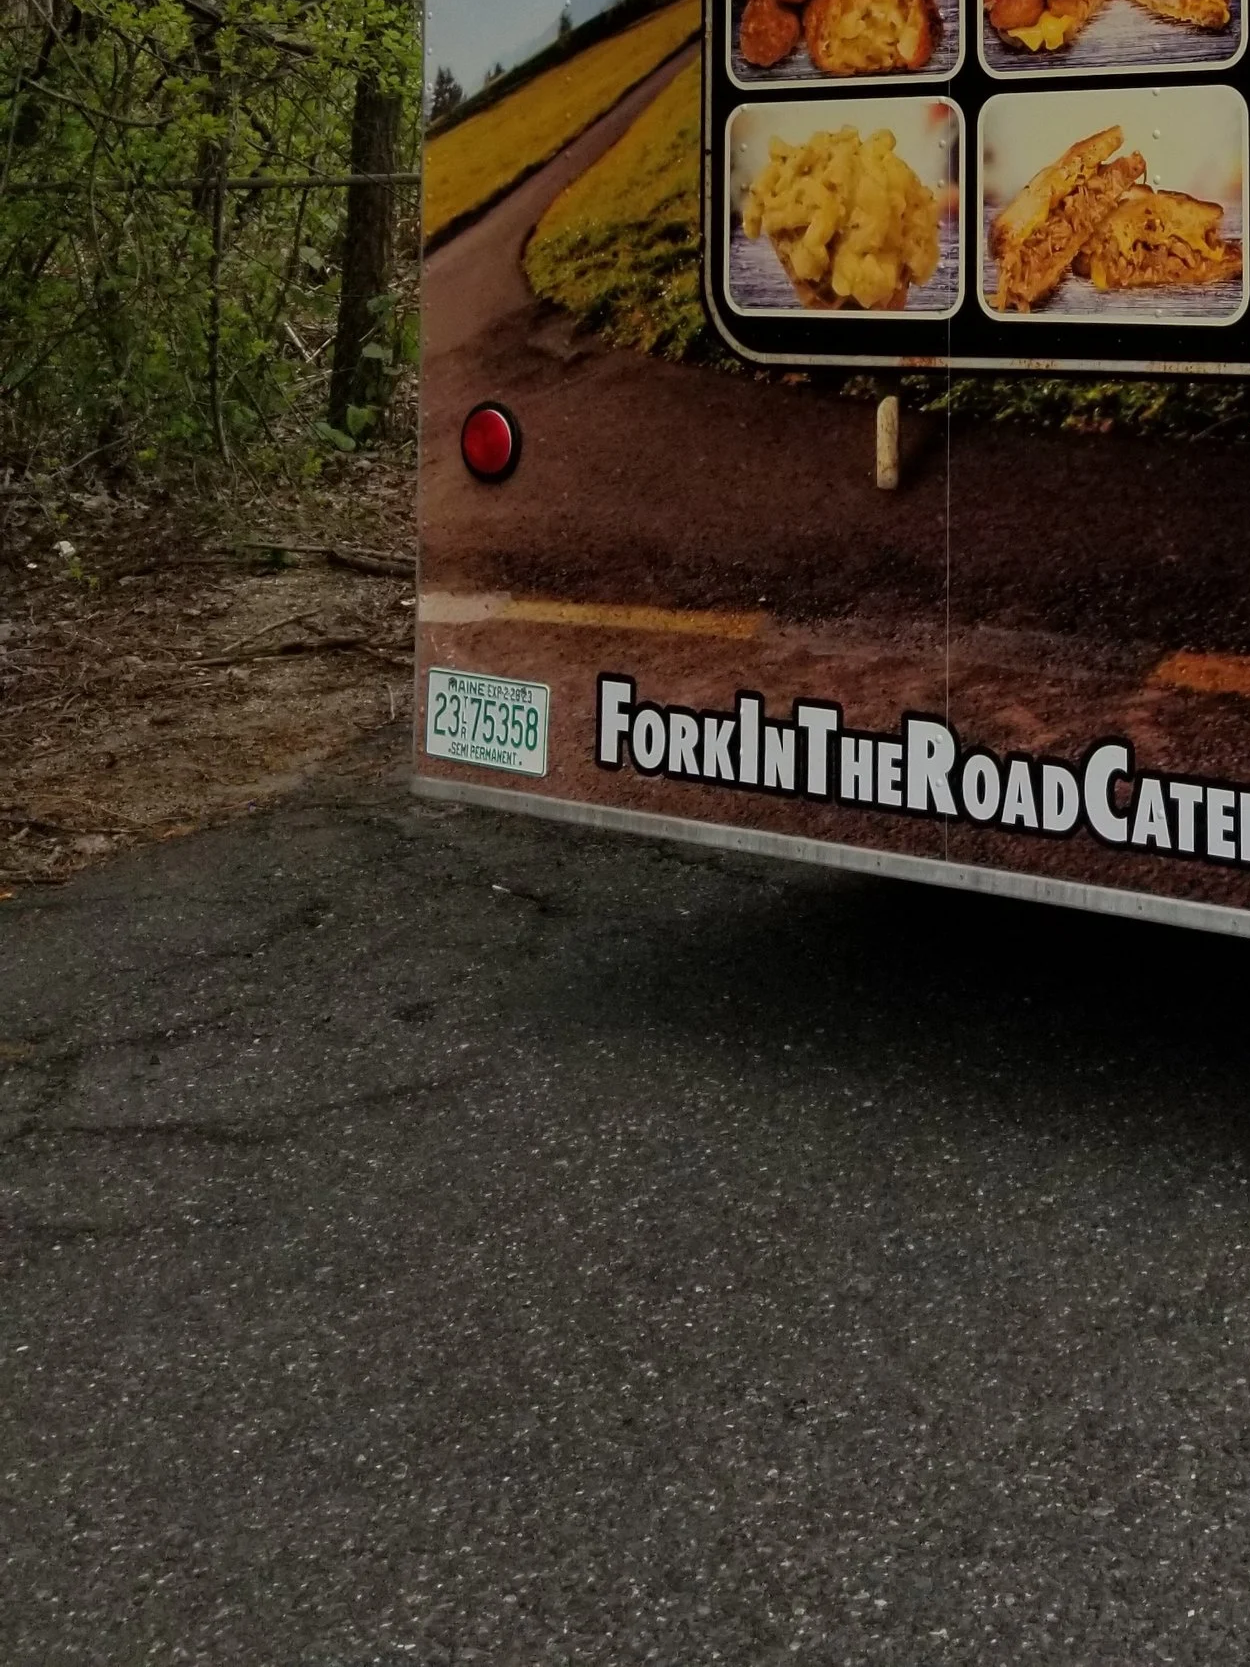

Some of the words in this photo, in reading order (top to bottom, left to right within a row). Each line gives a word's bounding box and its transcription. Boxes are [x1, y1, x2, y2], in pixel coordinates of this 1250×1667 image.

[448, 679, 485, 696] MAINE
[434, 692, 461, 737] 23
[470, 697, 539, 751] 75358
[451, 741, 469, 755] SEMI
[470, 745, 517, 765] PERMANENT
